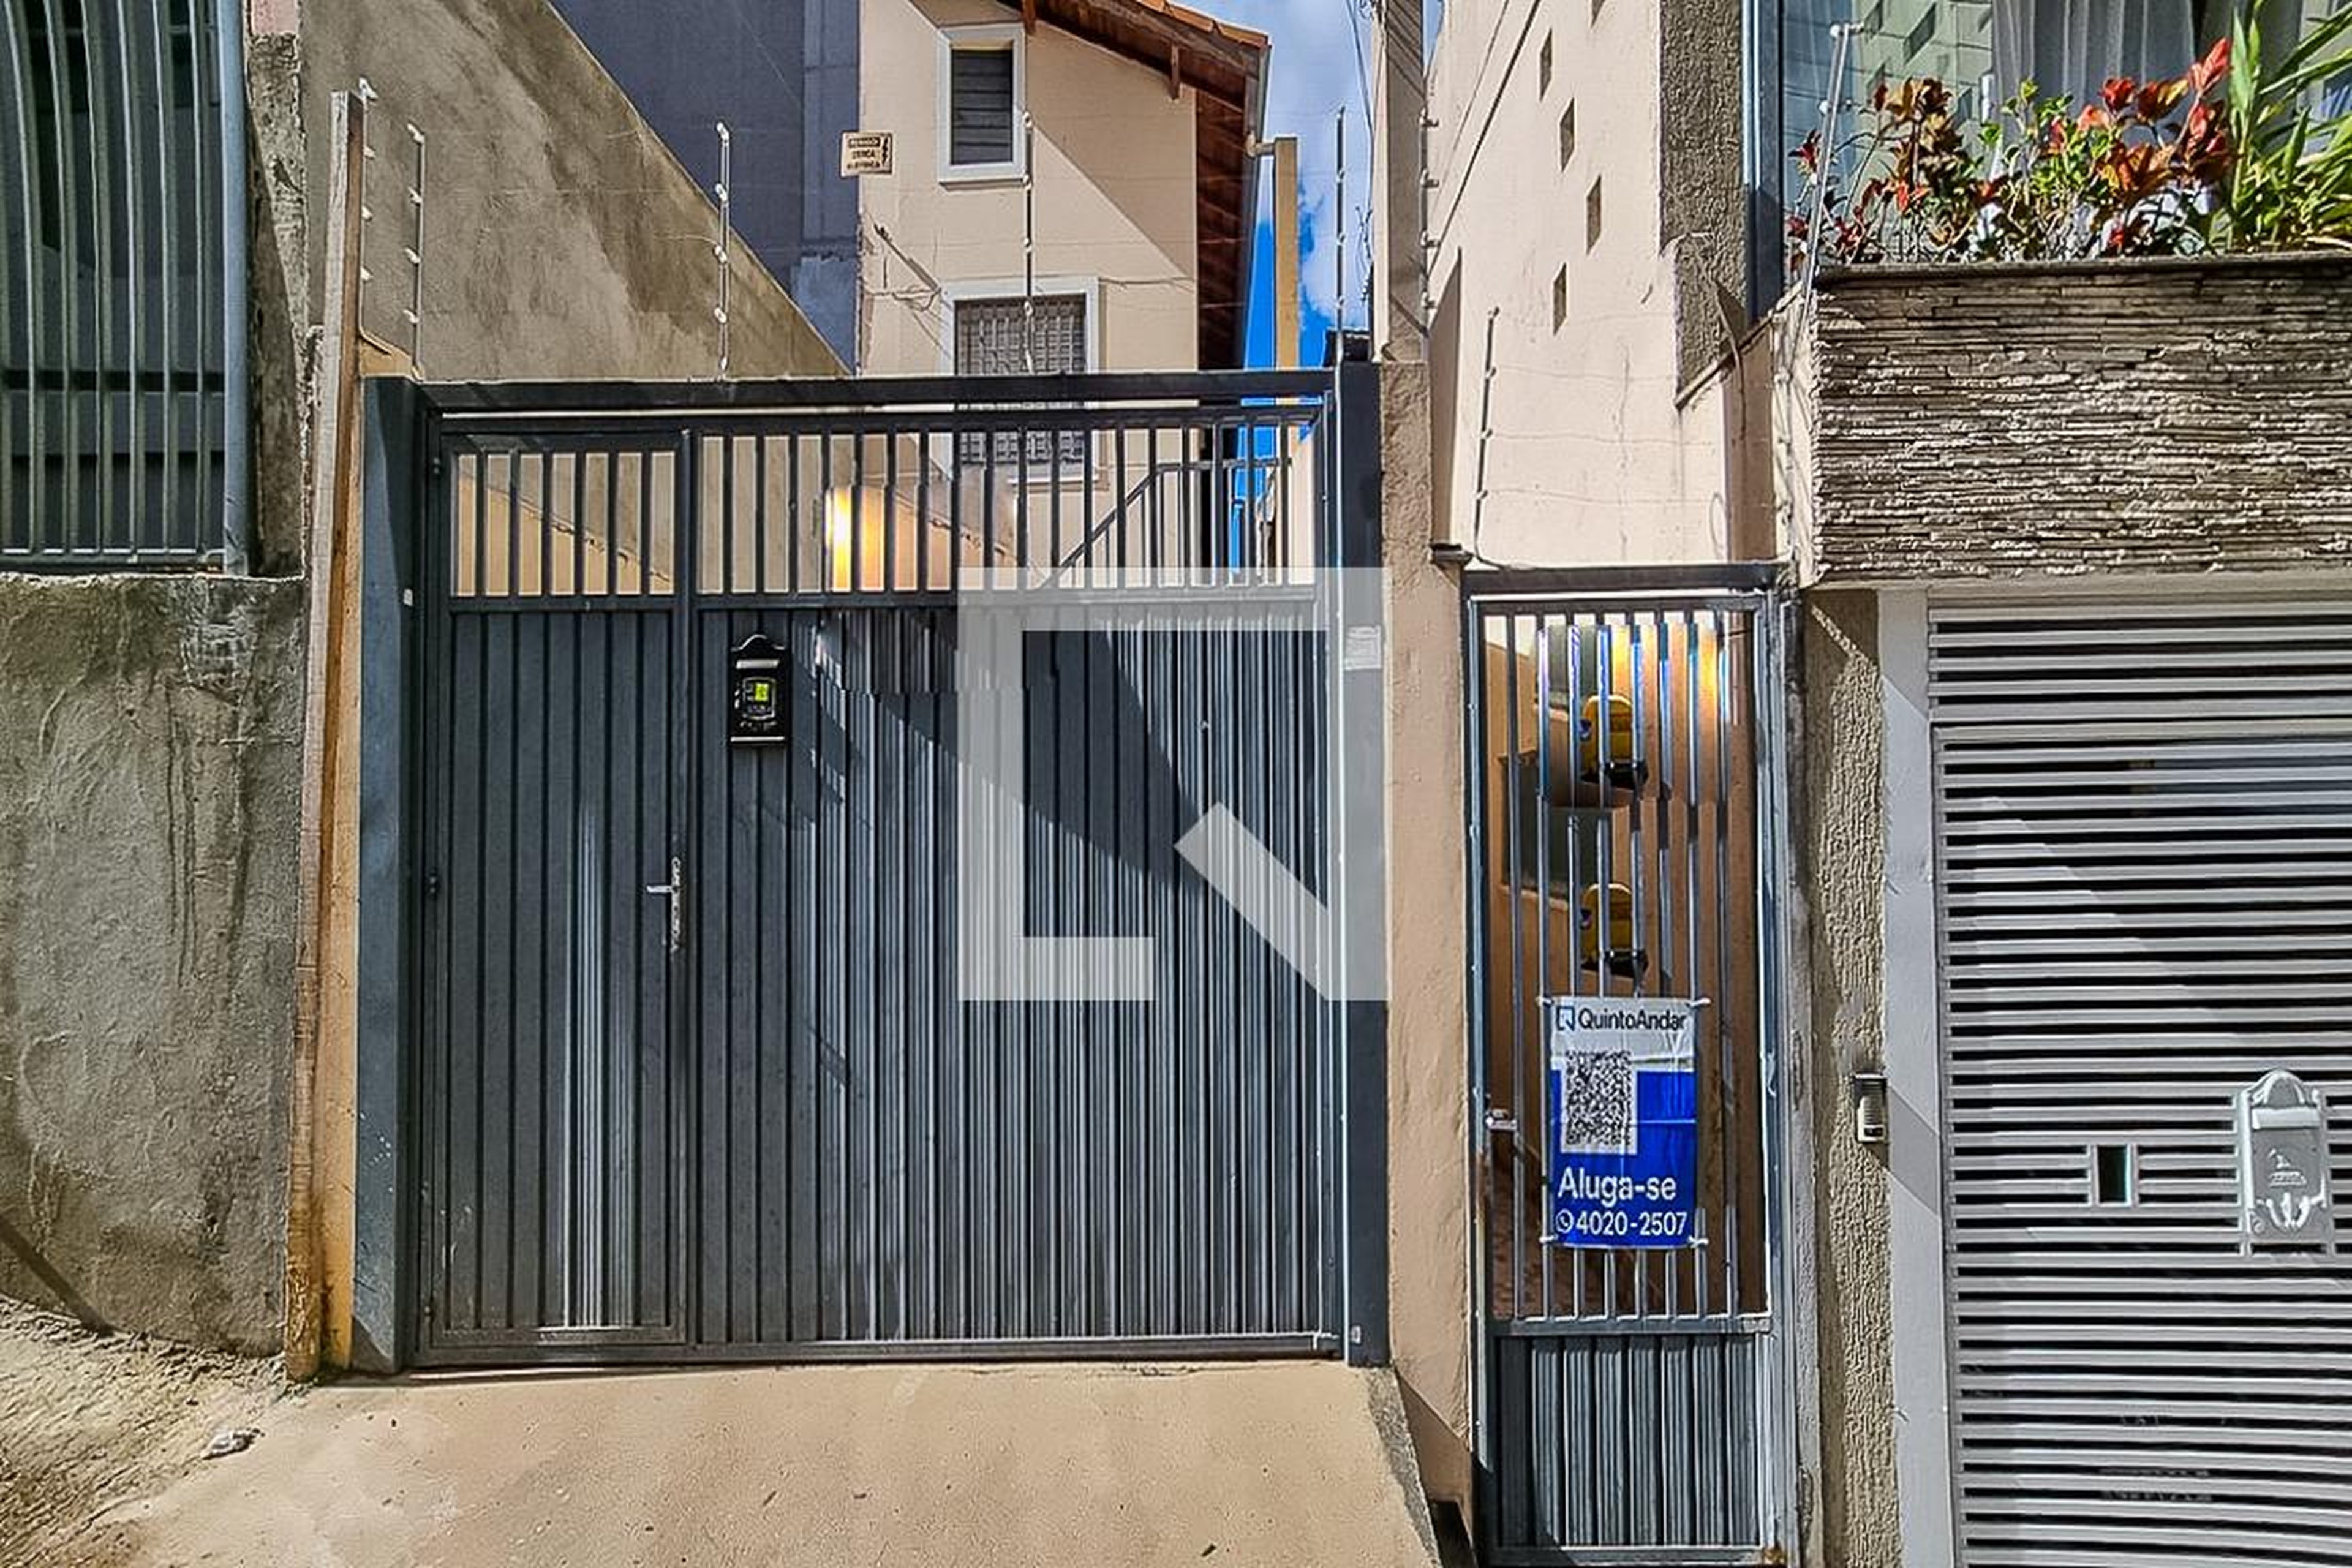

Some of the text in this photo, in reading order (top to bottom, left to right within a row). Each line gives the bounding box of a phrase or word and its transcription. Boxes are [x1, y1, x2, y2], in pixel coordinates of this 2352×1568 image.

[1578, 1008, 1687, 1030] QuintoAndar
[1558, 1167, 1676, 1208] Aluga-se
[1576, 1212, 1687, 1235] 4020-2507
